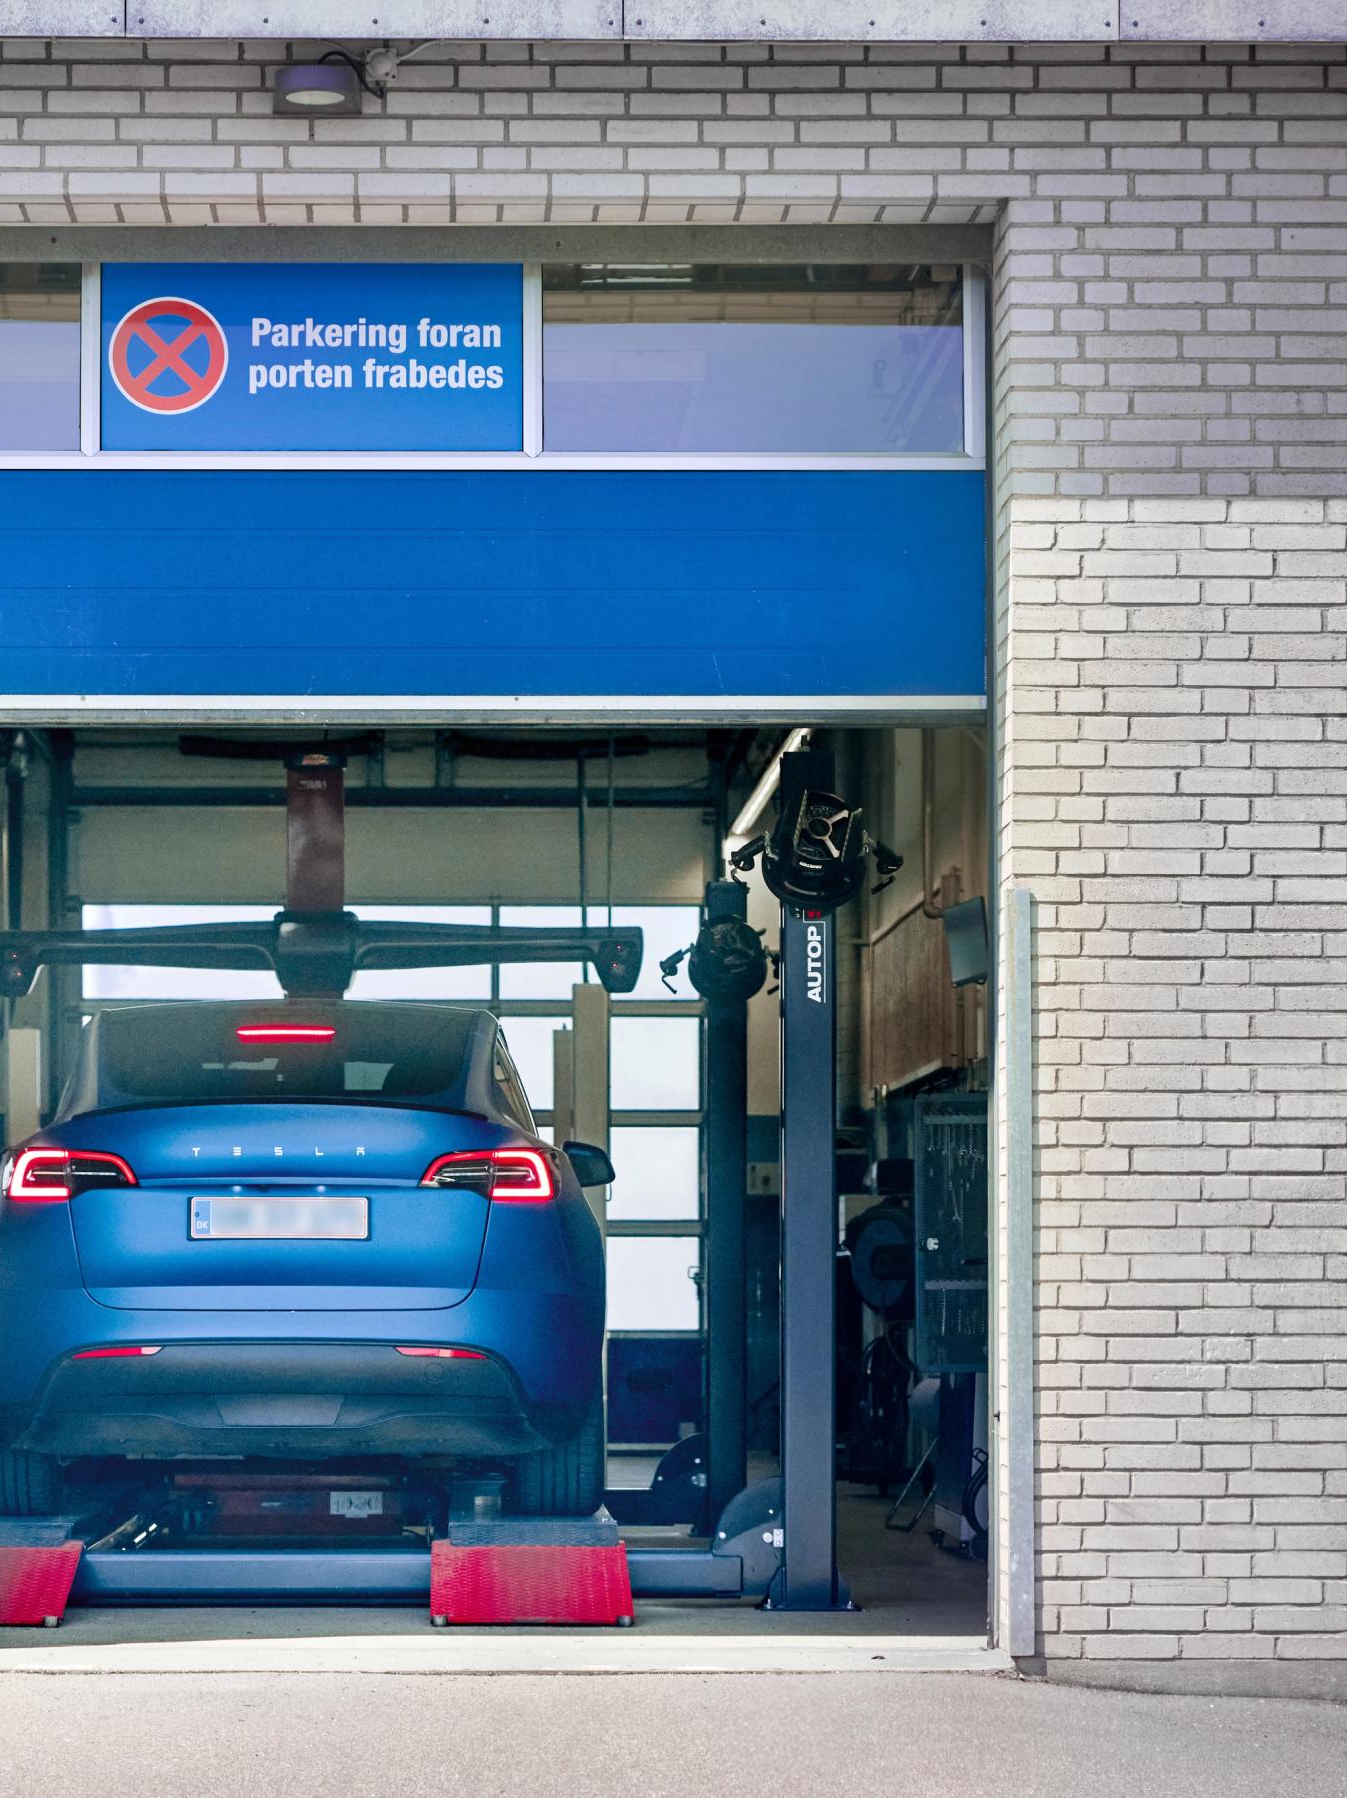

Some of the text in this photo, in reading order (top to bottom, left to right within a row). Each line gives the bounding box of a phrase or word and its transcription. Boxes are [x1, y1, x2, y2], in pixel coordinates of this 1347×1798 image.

[251, 317, 501, 354] Parkering foran
[249, 358, 504, 394] porten frabedes
[807, 925, 822, 1003] AUTOP
[192, 1146, 365, 1156] TESLA
[196, 1220, 209, 1230] DK
